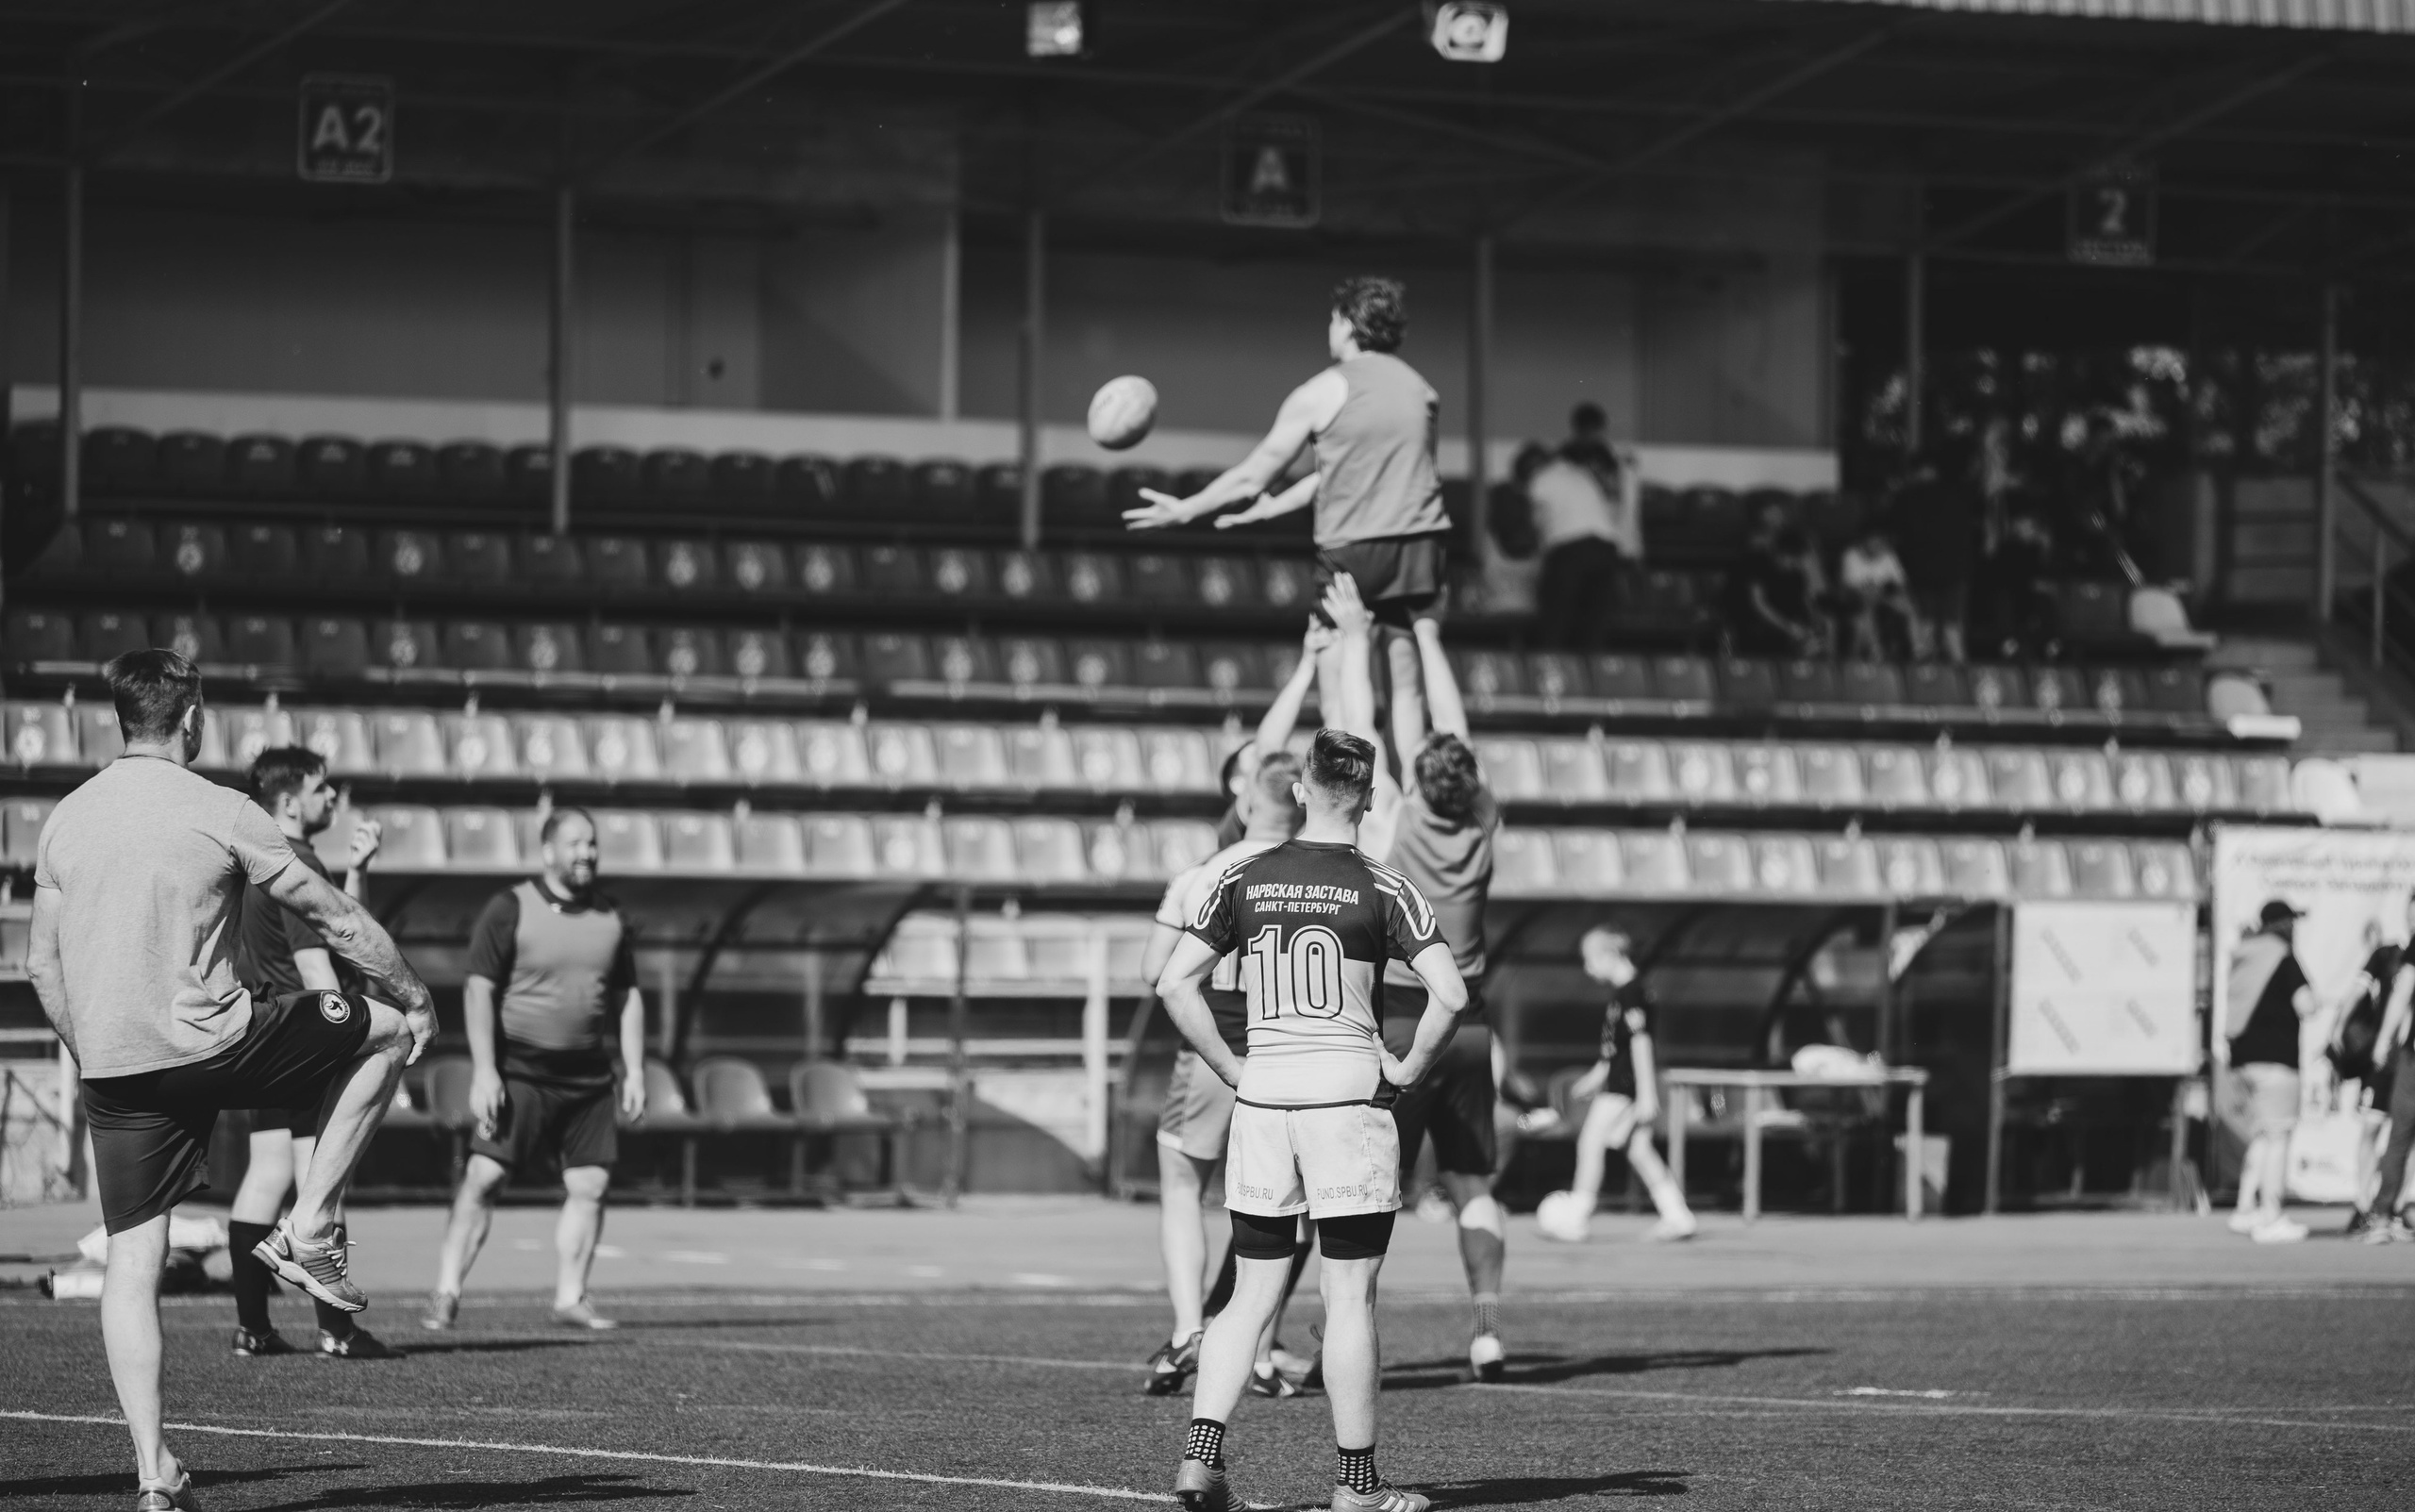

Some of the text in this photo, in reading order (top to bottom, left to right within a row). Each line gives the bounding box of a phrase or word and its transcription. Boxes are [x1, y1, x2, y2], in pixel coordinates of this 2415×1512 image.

[1246, 884, 1358, 905] НАРВСКАЯ ЗАСТАВА
[1255, 901, 1341, 915] САНКТ-ПЕТЕРБУРГ
[1248, 924, 1344, 1020] 10
[1317, 1184, 1368, 1200] FUND.SPBU.RU
